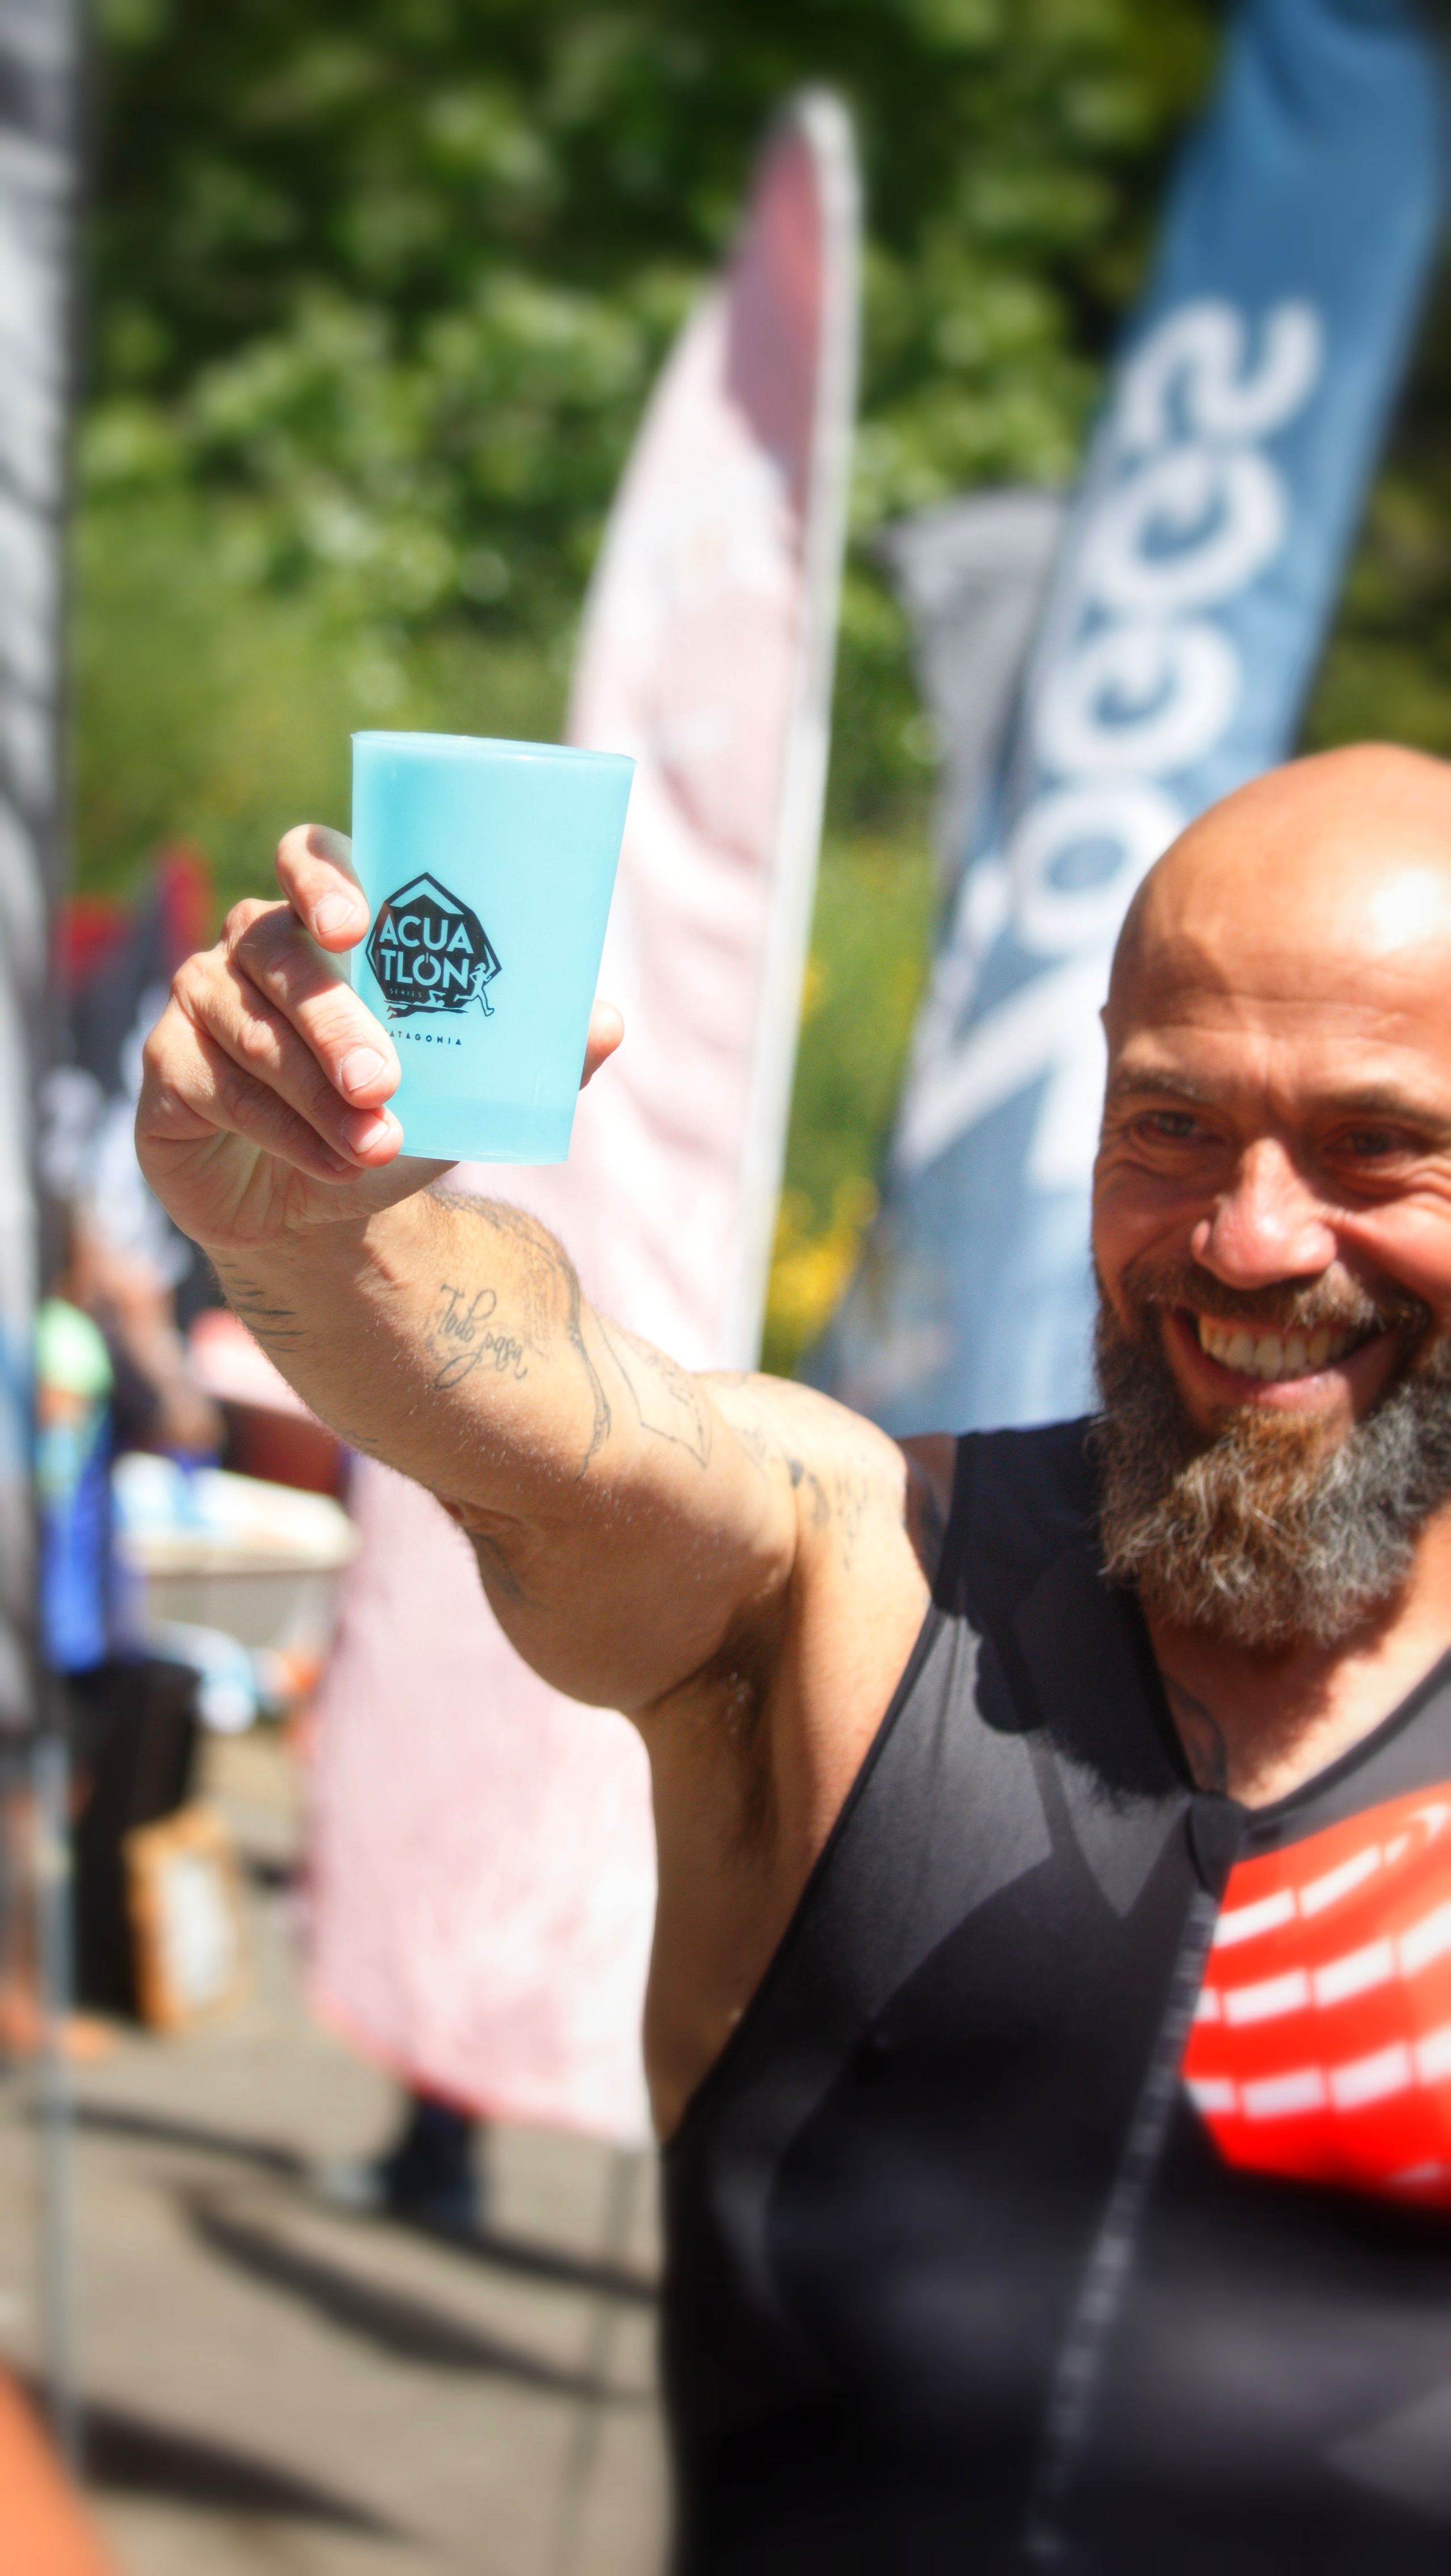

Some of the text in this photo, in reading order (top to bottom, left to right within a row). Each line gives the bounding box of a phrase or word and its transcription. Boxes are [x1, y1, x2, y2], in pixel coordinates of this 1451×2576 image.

[379, 913, 474, 954] ACUA
[389, 988, 422, 998] SERIES
[385, 1029, 462, 1046] ATAGONIA
